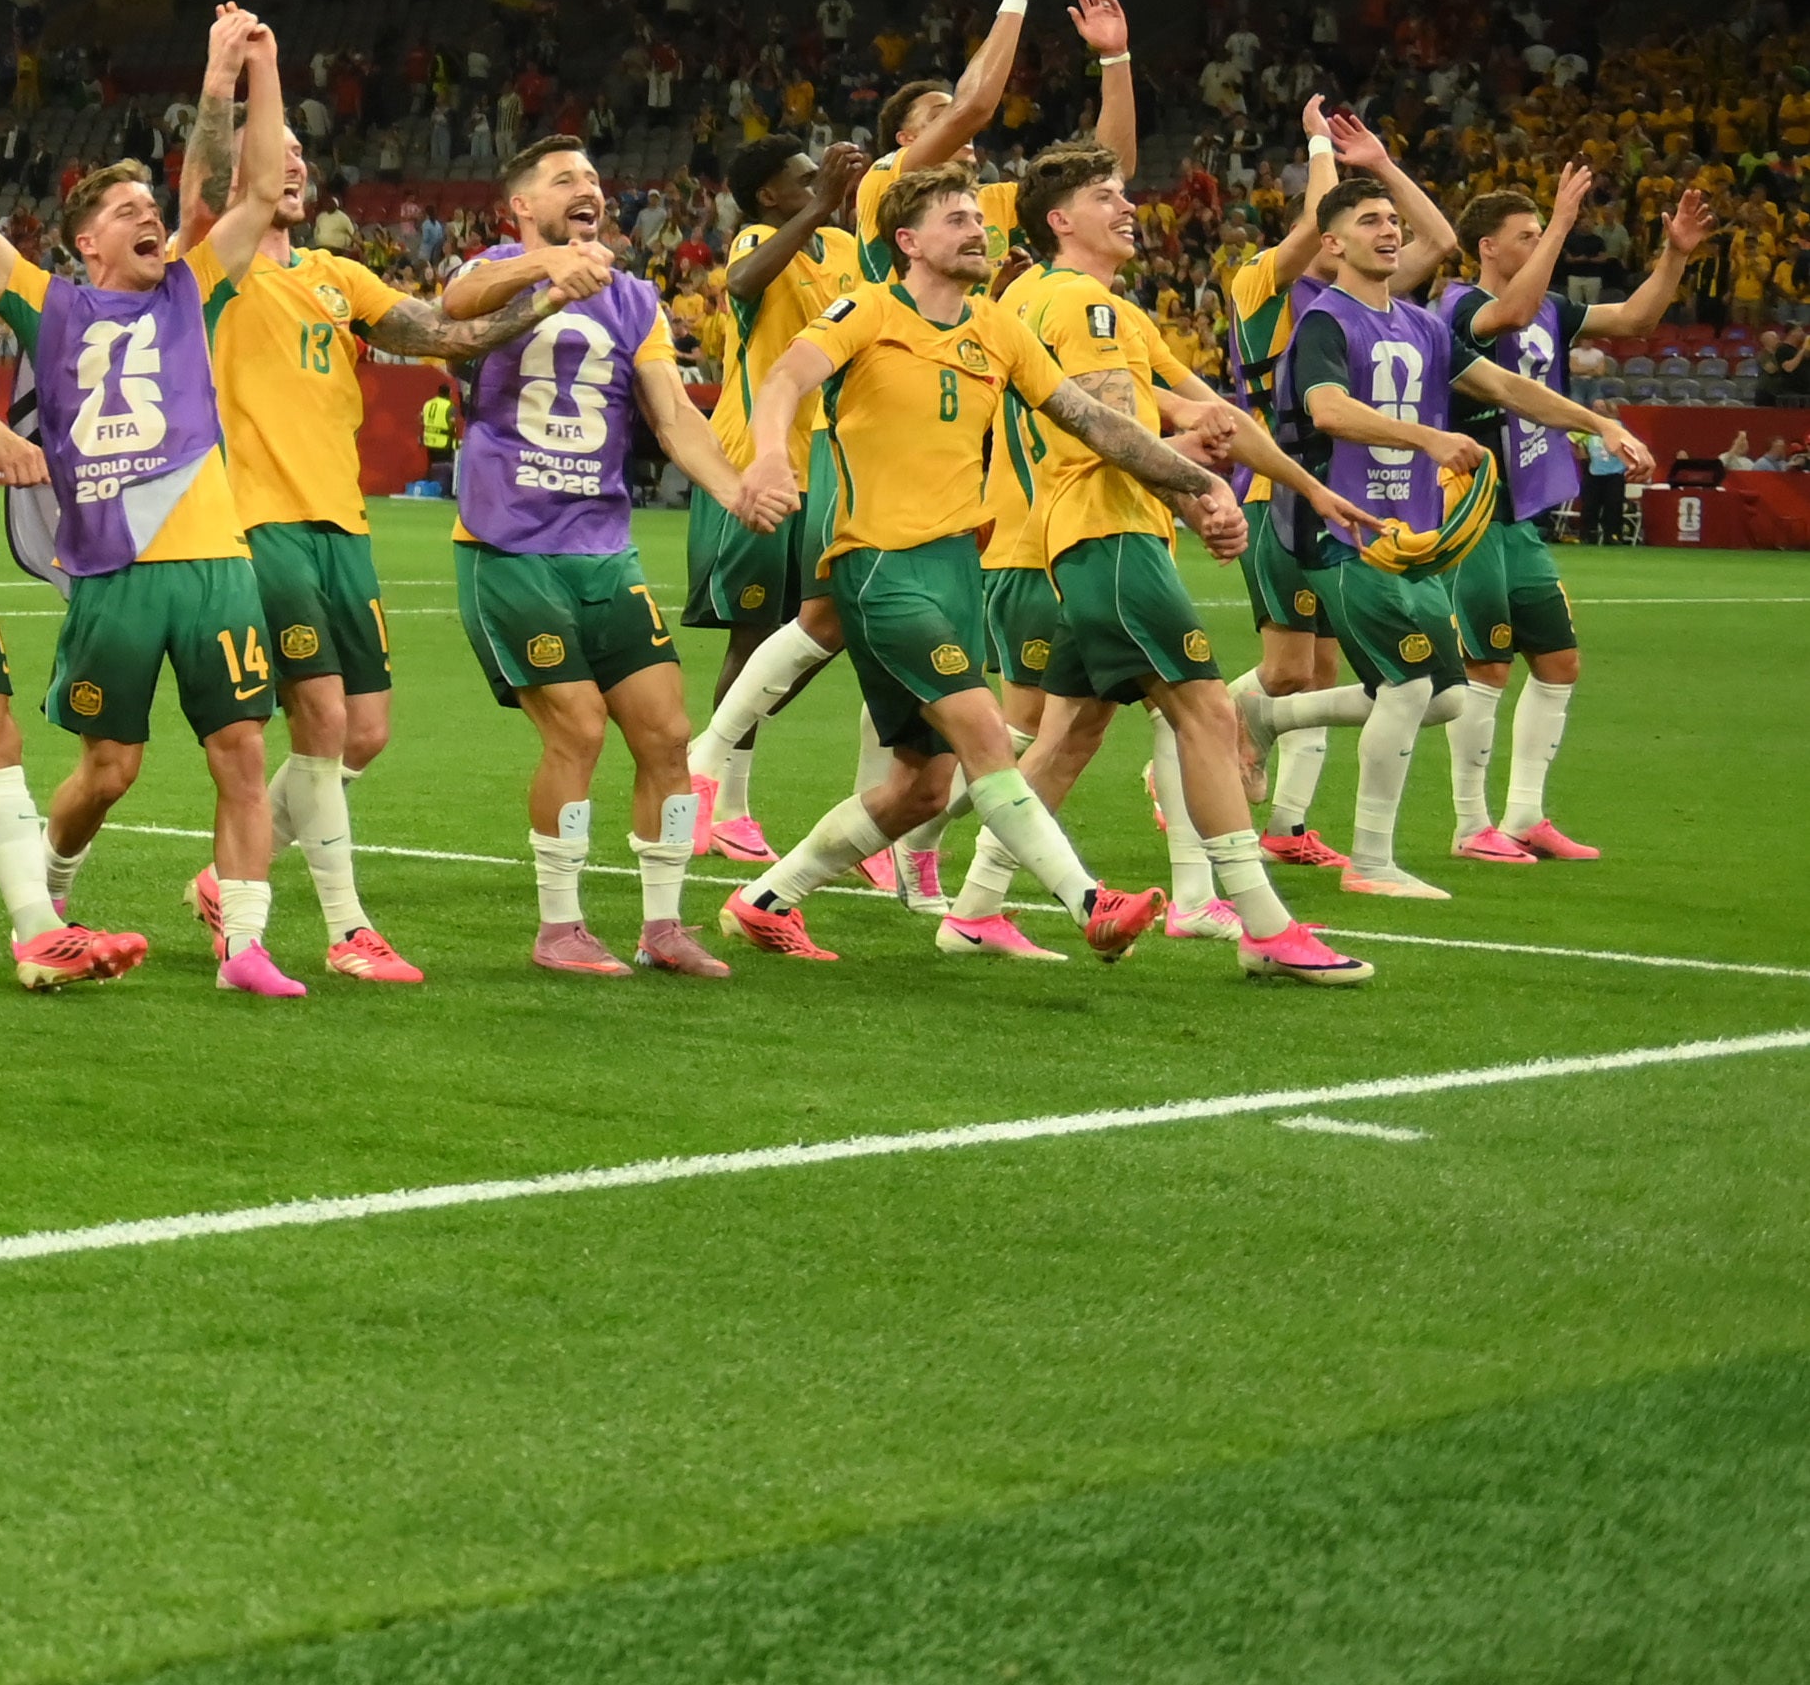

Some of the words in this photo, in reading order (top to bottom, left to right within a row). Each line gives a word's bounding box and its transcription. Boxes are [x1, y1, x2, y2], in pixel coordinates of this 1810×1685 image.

[300, 320, 334, 375] 13
[939, 369, 959, 422] 8
[96, 422, 140, 441] FIFA
[545, 423, 584, 439] FIFA
[74, 458, 132, 479] WORLD
[519, 449, 575, 471] WORLD
[575, 458, 602, 473] CUP
[515, 465, 601, 496] 2026
[217, 625, 269, 683] 14
